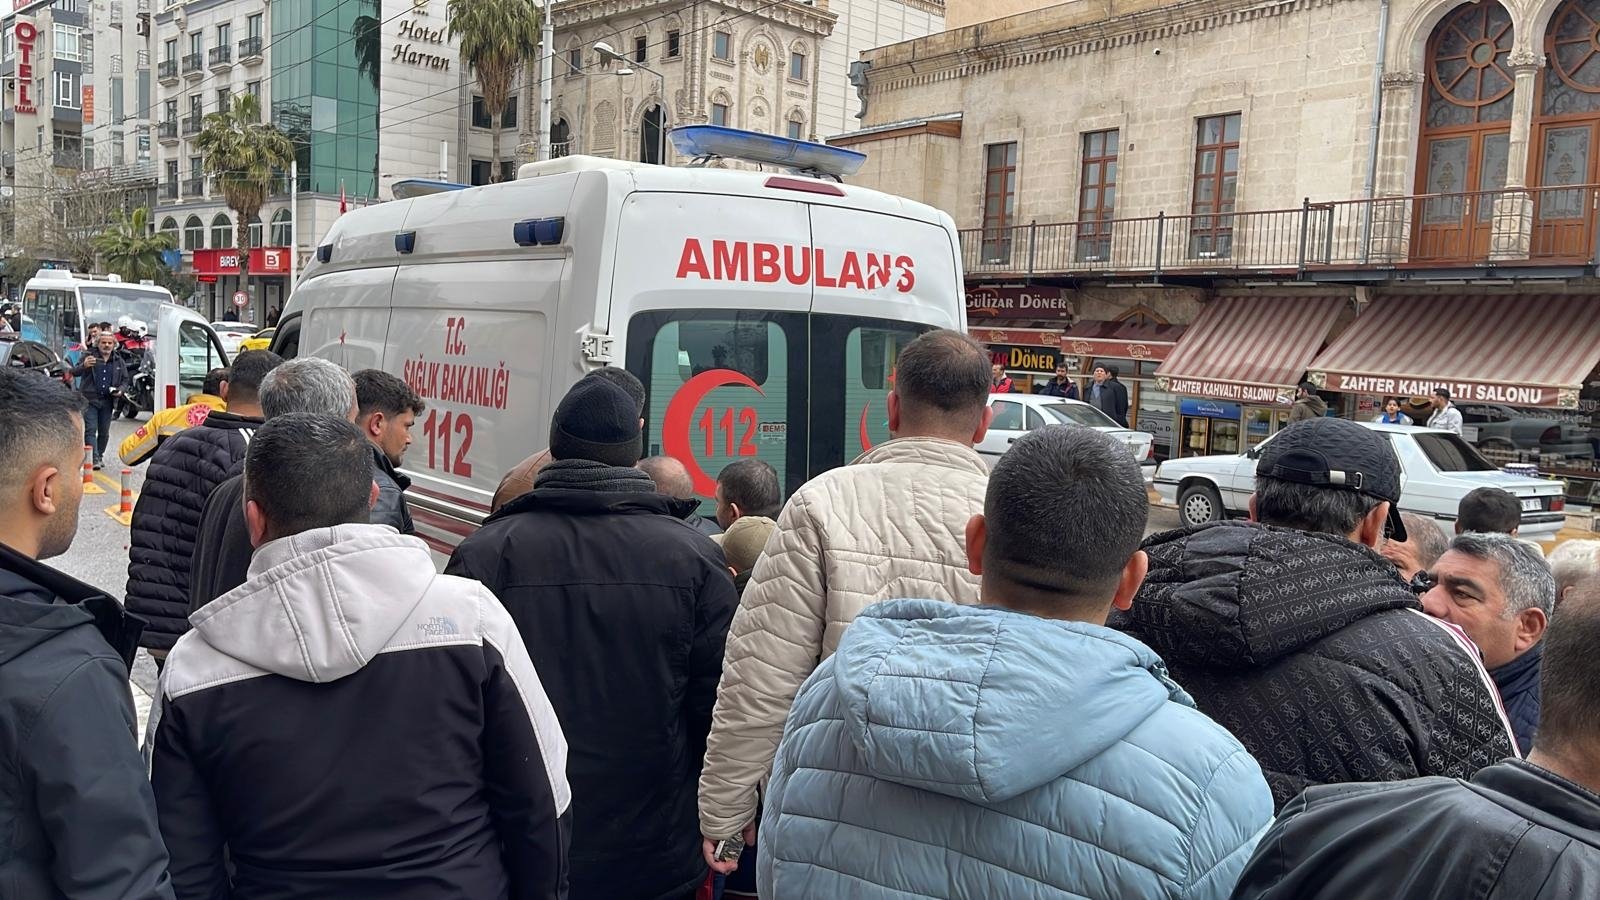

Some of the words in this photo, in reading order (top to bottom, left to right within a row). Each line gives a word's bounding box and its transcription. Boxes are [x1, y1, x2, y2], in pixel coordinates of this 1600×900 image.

[399, 19, 445, 44] Hotel
[15, 22, 37, 105] OTEL
[392, 44, 451, 71] Harran
[675, 237, 916, 293] AMBULANS
[1020, 294, 1067, 309] DÖNER
[445, 317, 467, 356] T.C.
[1010, 347, 1055, 370] DÖNER
[404, 354, 440, 401] SAĞLIK
[441, 361, 511, 410] BAKANLIĞI
[1171, 380, 1201, 394] ZAHTER
[1202, 383, 1241, 399] KAHVALTI
[1242, 386, 1276, 402] SALONU
[1340, 375, 1394, 394] ZAHTER
[1476, 384, 1543, 404] SALONU
[424, 409, 474, 479] 112
[699, 407, 758, 457] 112
[429, 615, 445, 624] THE
